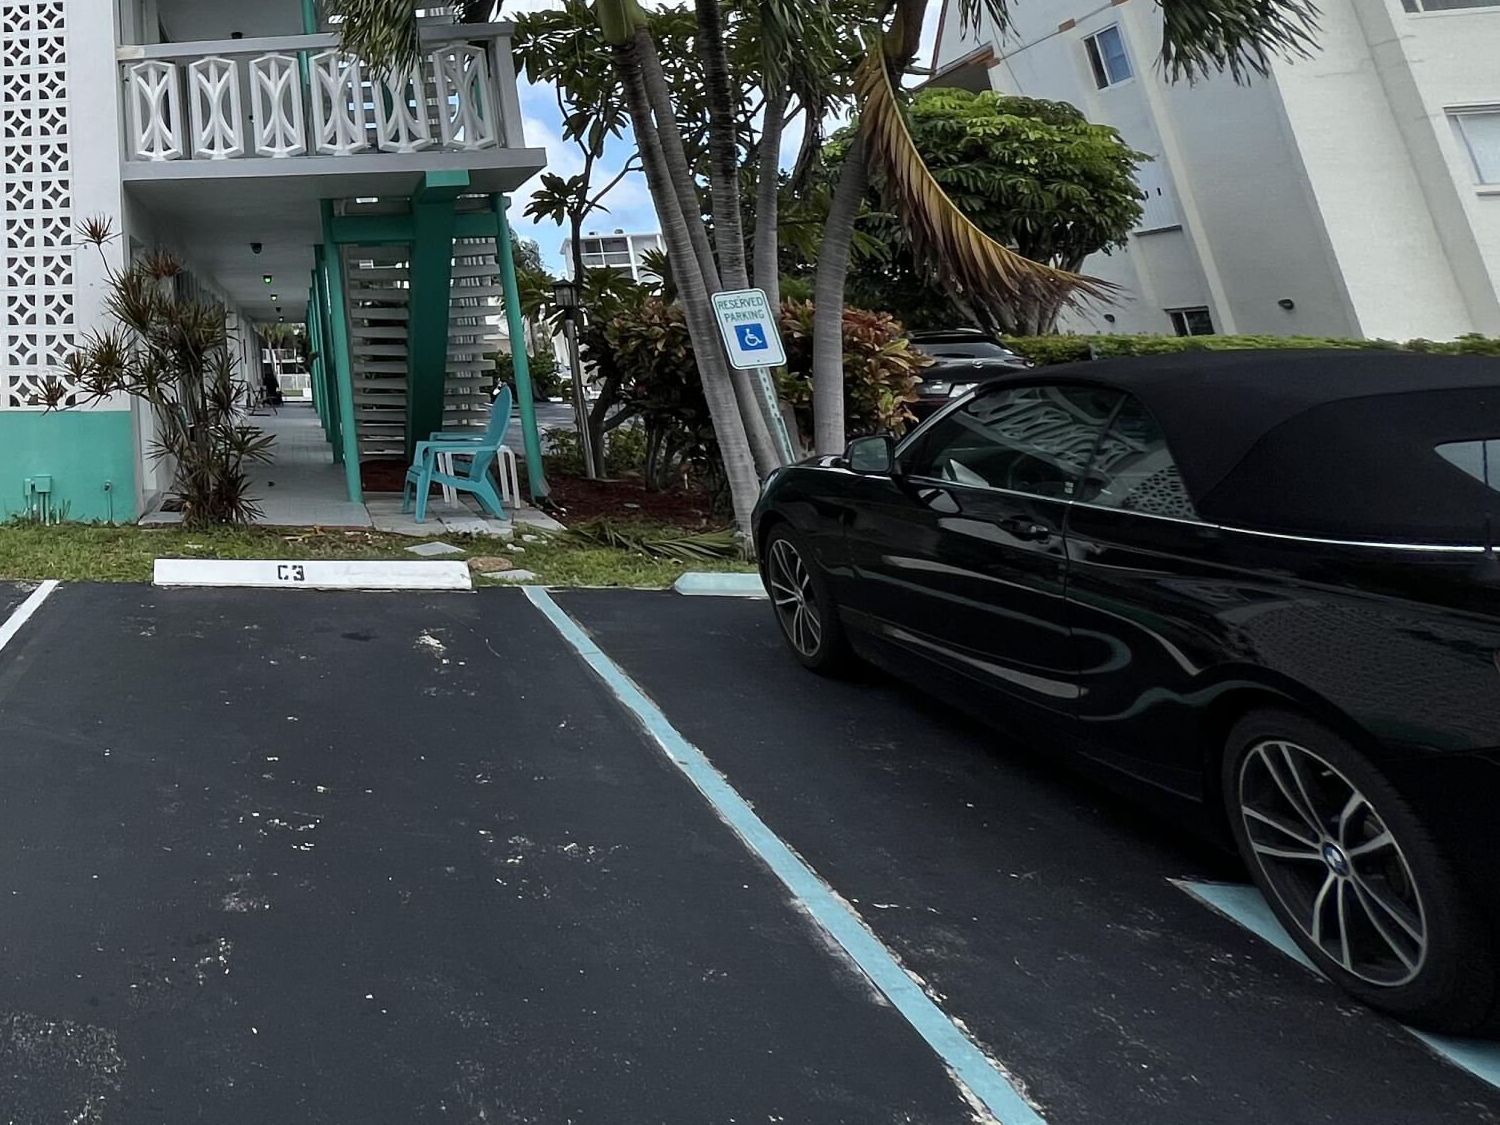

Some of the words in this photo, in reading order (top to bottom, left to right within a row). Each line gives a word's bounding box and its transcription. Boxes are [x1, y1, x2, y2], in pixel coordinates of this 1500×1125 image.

[717, 296, 764, 311] RESERVED
[724, 309, 765, 323] PARKING
[277, 564, 305, 581] C3
